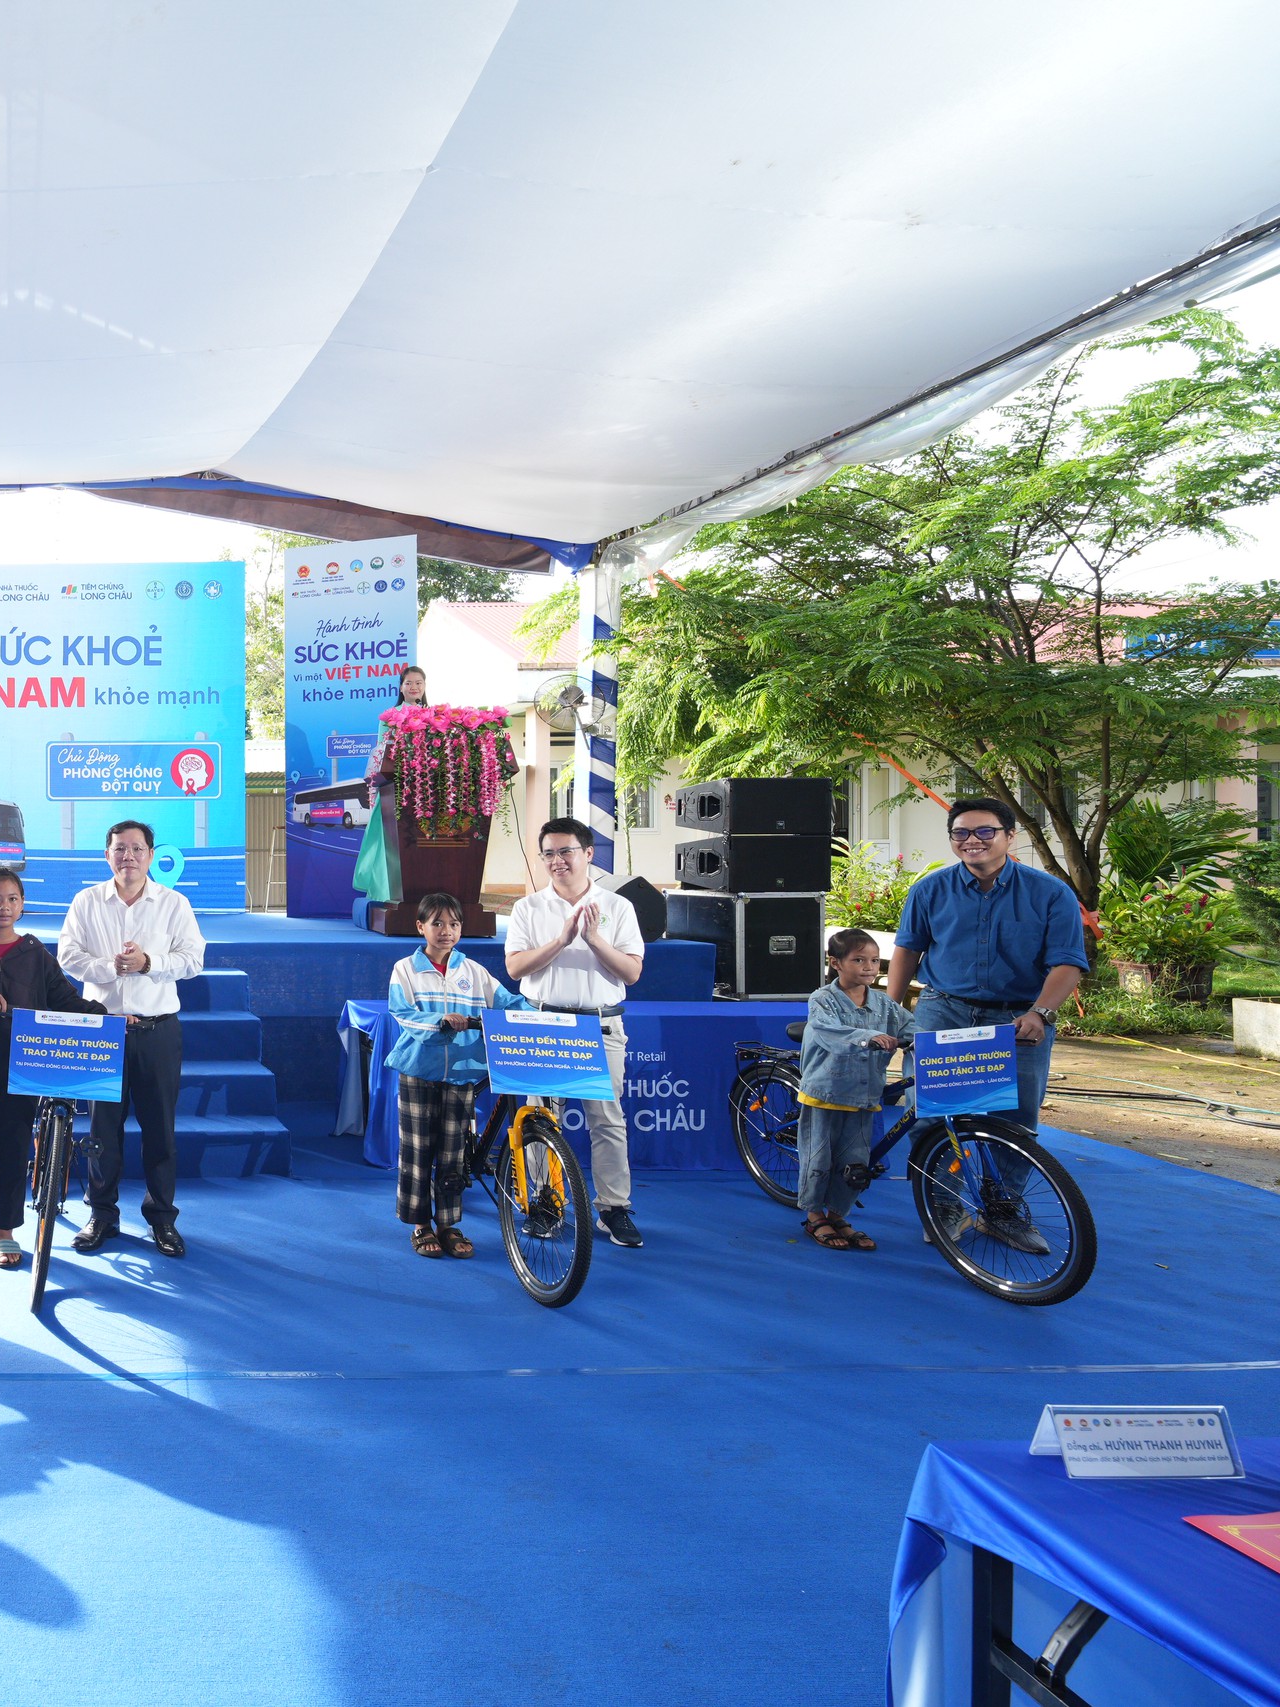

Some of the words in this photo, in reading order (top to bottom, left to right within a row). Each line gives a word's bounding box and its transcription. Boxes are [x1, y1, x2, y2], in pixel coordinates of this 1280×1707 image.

[15, 583, 38, 591] THUỐC
[26, 593, 49, 601] CHÂU
[108, 591, 132, 600] CHÂU
[316, 617, 350, 638] Hành
[352, 612, 383, 629] trình
[63, 625, 163, 666] KHOẺ
[294, 640, 339, 664] SỨC
[346, 632, 407, 660] KHOẺ
[294, 674, 303, 682] Vì
[305, 673, 322, 683] một
[325, 664, 362, 682] VIỆT
[367, 662, 408, 679] NAM
[94, 686, 150, 705] khỏe
[158, 687, 220, 709] mạnh
[303, 687, 344, 702] khỏe
[350, 684, 398, 701] mạnh
[58, 748, 84, 765] Chủ
[84, 748, 120, 769] Động
[63, 765, 110, 779] PHÒNG
[114, 763, 163, 778] CHỐNG
[102, 779, 130, 794] ĐỘT
[133, 781, 162, 794] QUỴ
[16, 1034, 41, 1043] CÙNG
[59, 1037, 78, 1046] ĐẾN
[81, 1040, 119, 1049] TRƯỜNG
[490, 1033, 517, 1042] CÙNG
[536, 1035, 556, 1045] ĐẾN
[559, 1038, 599, 1048] TRƯỜNG
[22, 1048, 47, 1056] TRAO
[50, 1049, 74, 1059] TẶNG
[77, 1052, 88, 1060] XE
[91, 1053, 110, 1062] ĐẠP
[499, 1047, 526, 1055] TRAO
[528, 1048, 555, 1058] TẶNG
[572, 1052, 592, 1061] ĐẠP
[638, 1051, 665, 1062] Retail
[920, 1056, 943, 1066] CÙNG
[945, 1055, 957, 1063] EM
[959, 1052, 976, 1062] ĐẾN
[978, 1050, 1011, 1060] TRƯỜNG
[927, 1069, 949, 1078] TRAO
[951, 1065, 973, 1077] TẶNG
[975, 1065, 985, 1073] XE
[987, 1063, 1005, 1073] ĐẠP
[634, 1103, 706, 1131] CHÂU
[1104, 1437, 1142, 1450] HUỲNH
[1144, 1440, 1182, 1450] THANH
[1186, 1440, 1224, 1450] HUYNH
